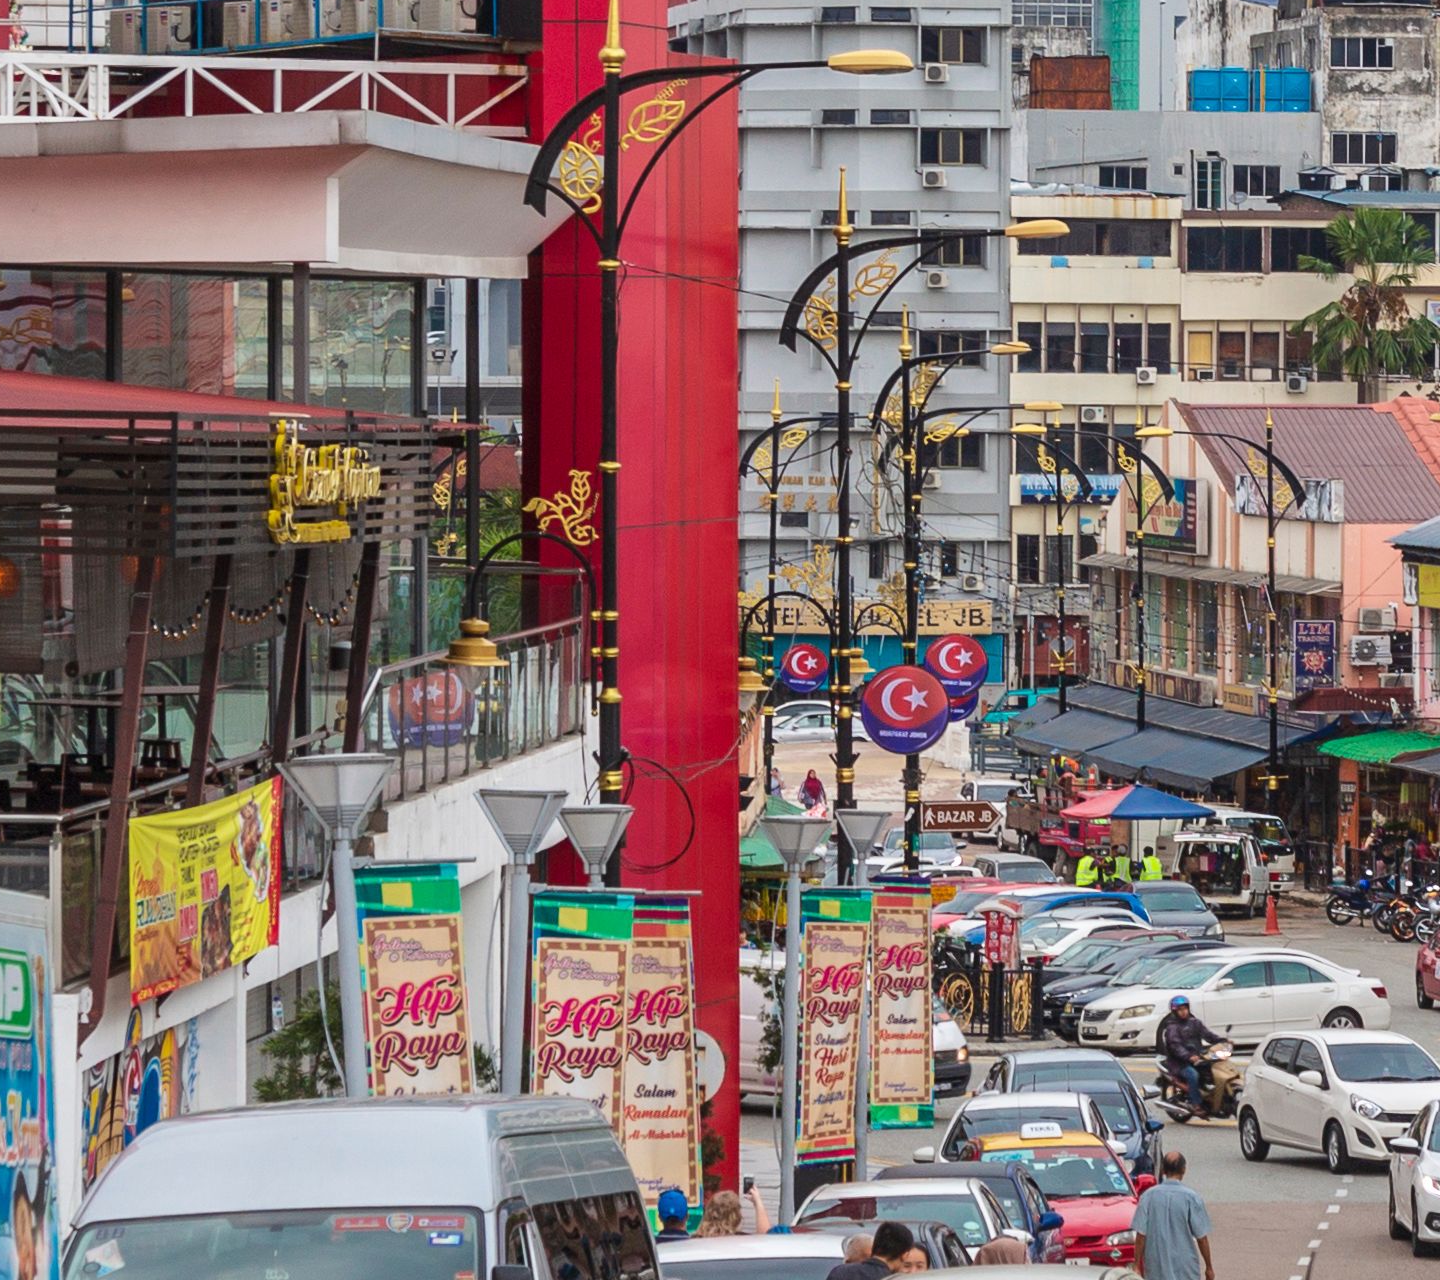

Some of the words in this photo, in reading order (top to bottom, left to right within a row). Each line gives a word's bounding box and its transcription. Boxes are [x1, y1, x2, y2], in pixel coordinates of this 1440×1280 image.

[954, 608, 986, 627] JB
[1298, 623, 1331, 635] LTM
[937, 809, 975, 823] BAZAR
[978, 809, 993, 822] JB
[874, 972, 929, 1000] Raya
[806, 995, 860, 1028] Raya
[879, 1029, 926, 1042] Ramadan
[375, 1030, 466, 1075] Raya
[624, 1028, 690, 1066] Raya
[536, 1041, 623, 1081] Raya
[814, 1046, 849, 1070] Hari
[633, 1083, 678, 1099] Salam
[623, 1104, 689, 1121] Ramadan
